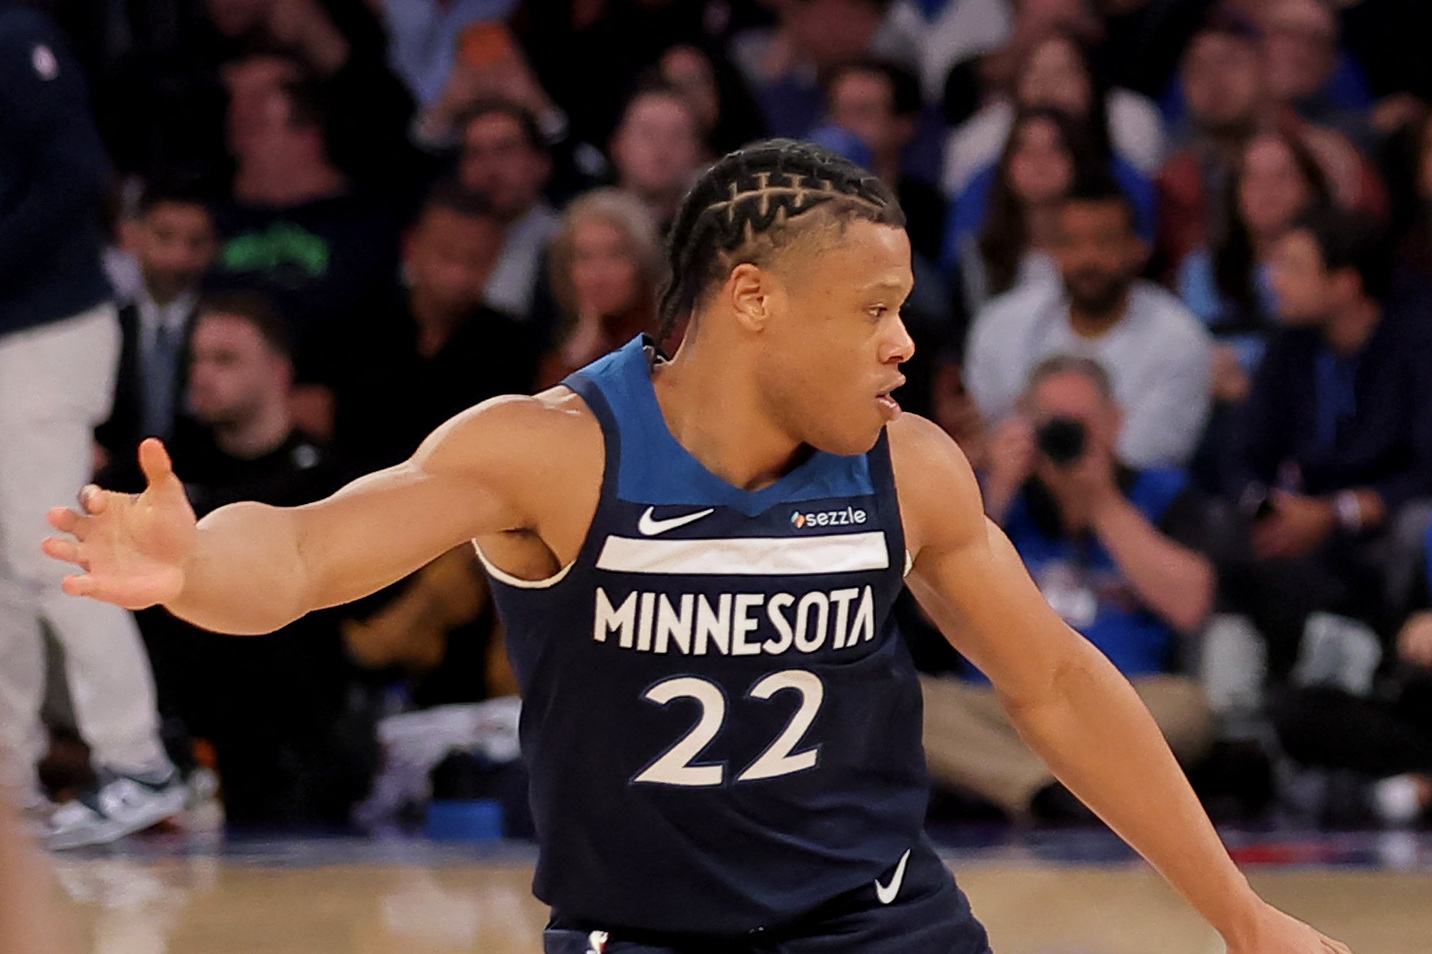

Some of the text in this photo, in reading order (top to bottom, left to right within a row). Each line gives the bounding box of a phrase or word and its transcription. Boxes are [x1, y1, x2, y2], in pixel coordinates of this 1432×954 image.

[805, 506, 867, 527] sezzle
[593, 584, 875, 656] MINNESOTA
[629, 668, 826, 788] 22
